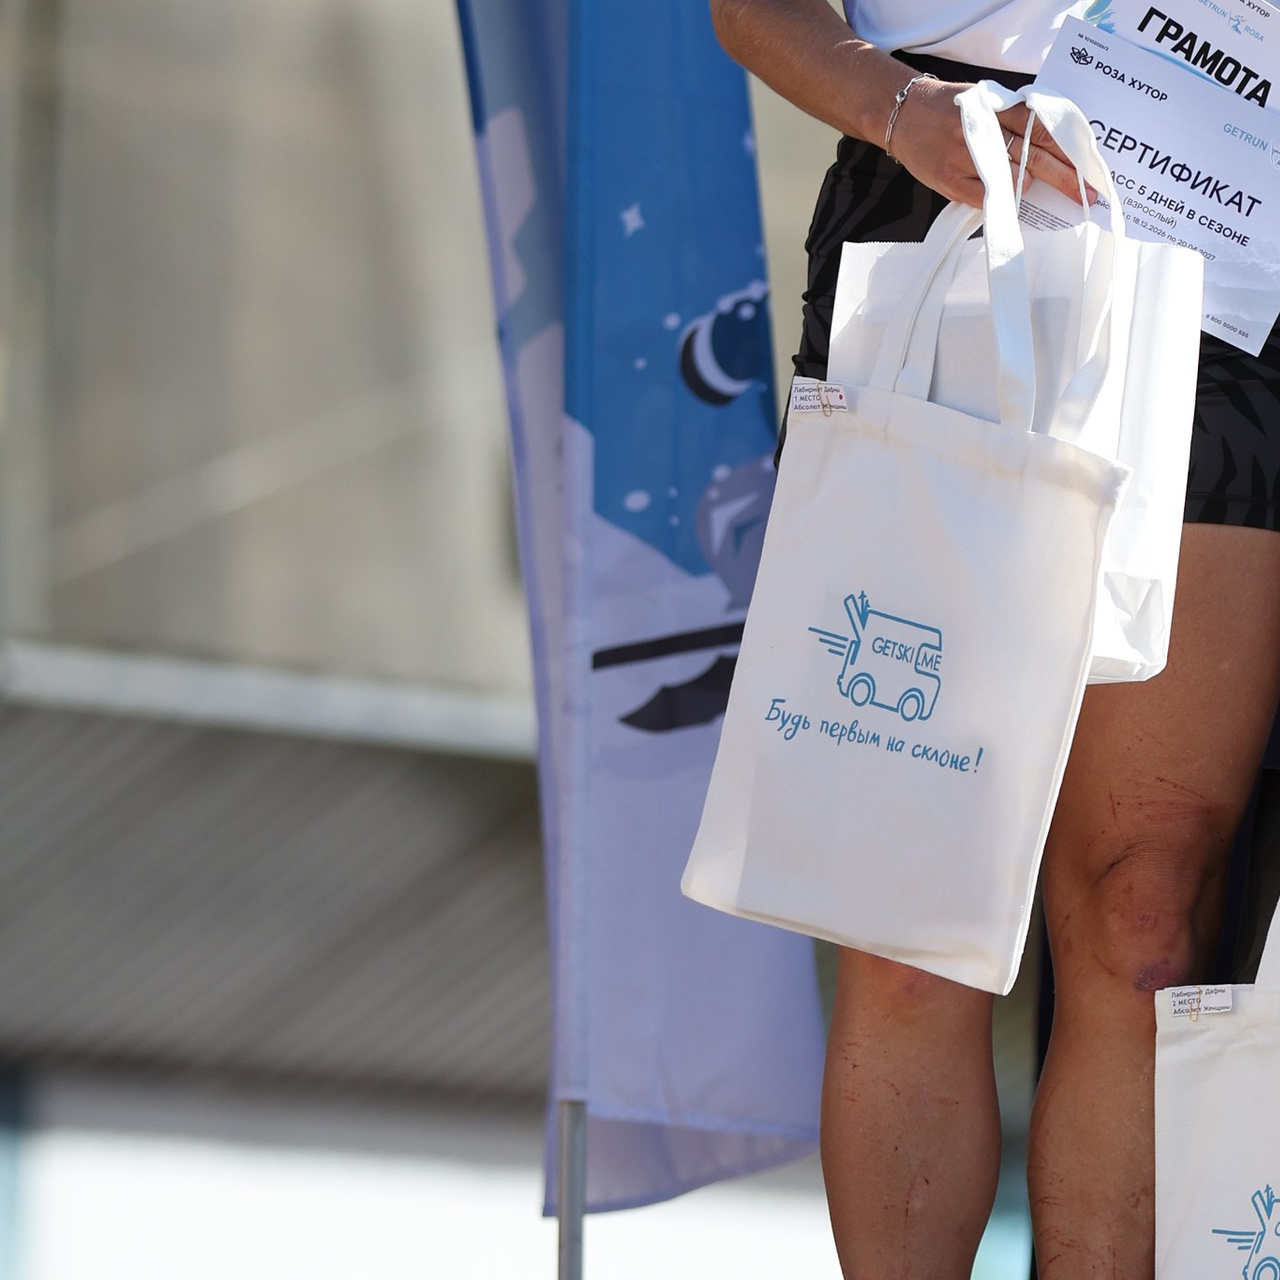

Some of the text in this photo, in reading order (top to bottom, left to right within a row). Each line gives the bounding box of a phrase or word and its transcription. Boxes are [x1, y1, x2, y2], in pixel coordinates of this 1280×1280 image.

[1246, 0, 1271, 19] ХУТОР
[1244, 25, 1264, 43] ROSA
[1136, 6, 1272, 108] ГРАМОТА
[1094, 61, 1168, 101] РОЗА ХУТОР
[1223, 123, 1268, 151] GETRUN
[1089, 119, 1262, 218] СЕРТИФИКАТ
[1123, 196, 1178, 230] (ВЗРОСЛЫЙ)
[1138, 185, 1148, 195] 5
[1147, 191, 1185, 216] ДНЕЙ
[1186, 209, 1196, 220] В
[1198, 215, 1250, 247] СЕЗОНЕ
[1166, 234, 1177, 243] по
[765, 698, 810, 741] Будь
[819, 719, 880, 750] первым
[886, 736, 905, 755] на
